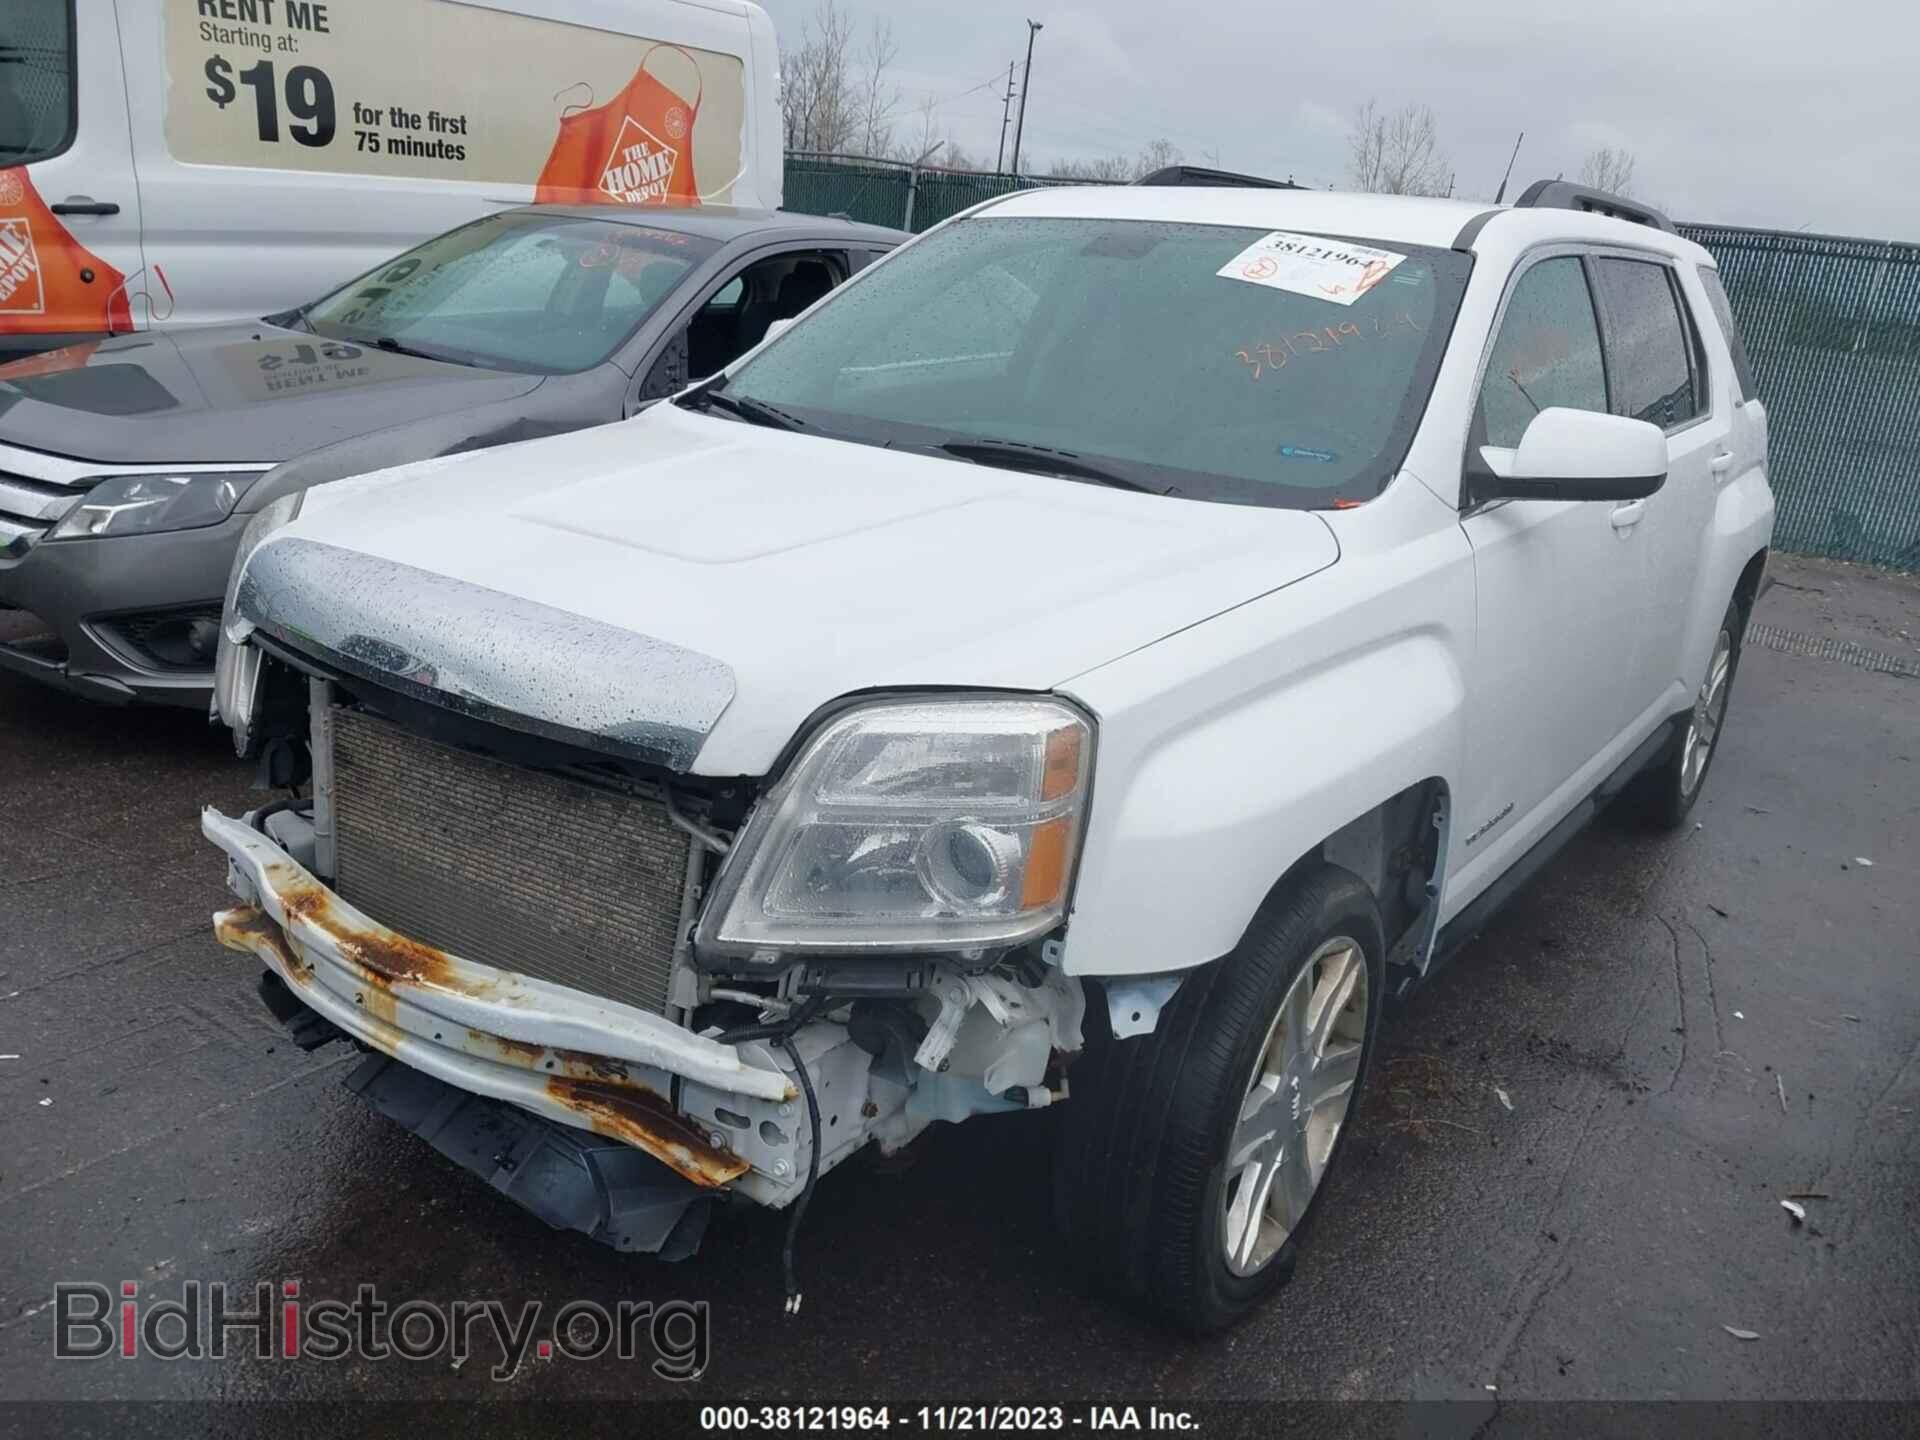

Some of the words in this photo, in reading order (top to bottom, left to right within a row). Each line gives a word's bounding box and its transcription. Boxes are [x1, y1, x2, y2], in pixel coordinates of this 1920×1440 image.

[198, 0, 273, 25] RENT
[287, 0, 330, 33] ME
[199, 21, 271, 53] Starting
[277, 34, 299, 52] at:
[204, 54, 336, 148] $19
[353, 102, 383, 126] for
[390, 107, 422, 131] the
[427, 112, 467, 135] first
[354, 131, 380, 153] 75
[387, 136, 466, 161] minutes
[623, 141, 650, 162] THE
[606, 149, 672, 194] HOME
[625, 179, 665, 203] DEPOT
[1266, 240, 1376, 269] 38121964
